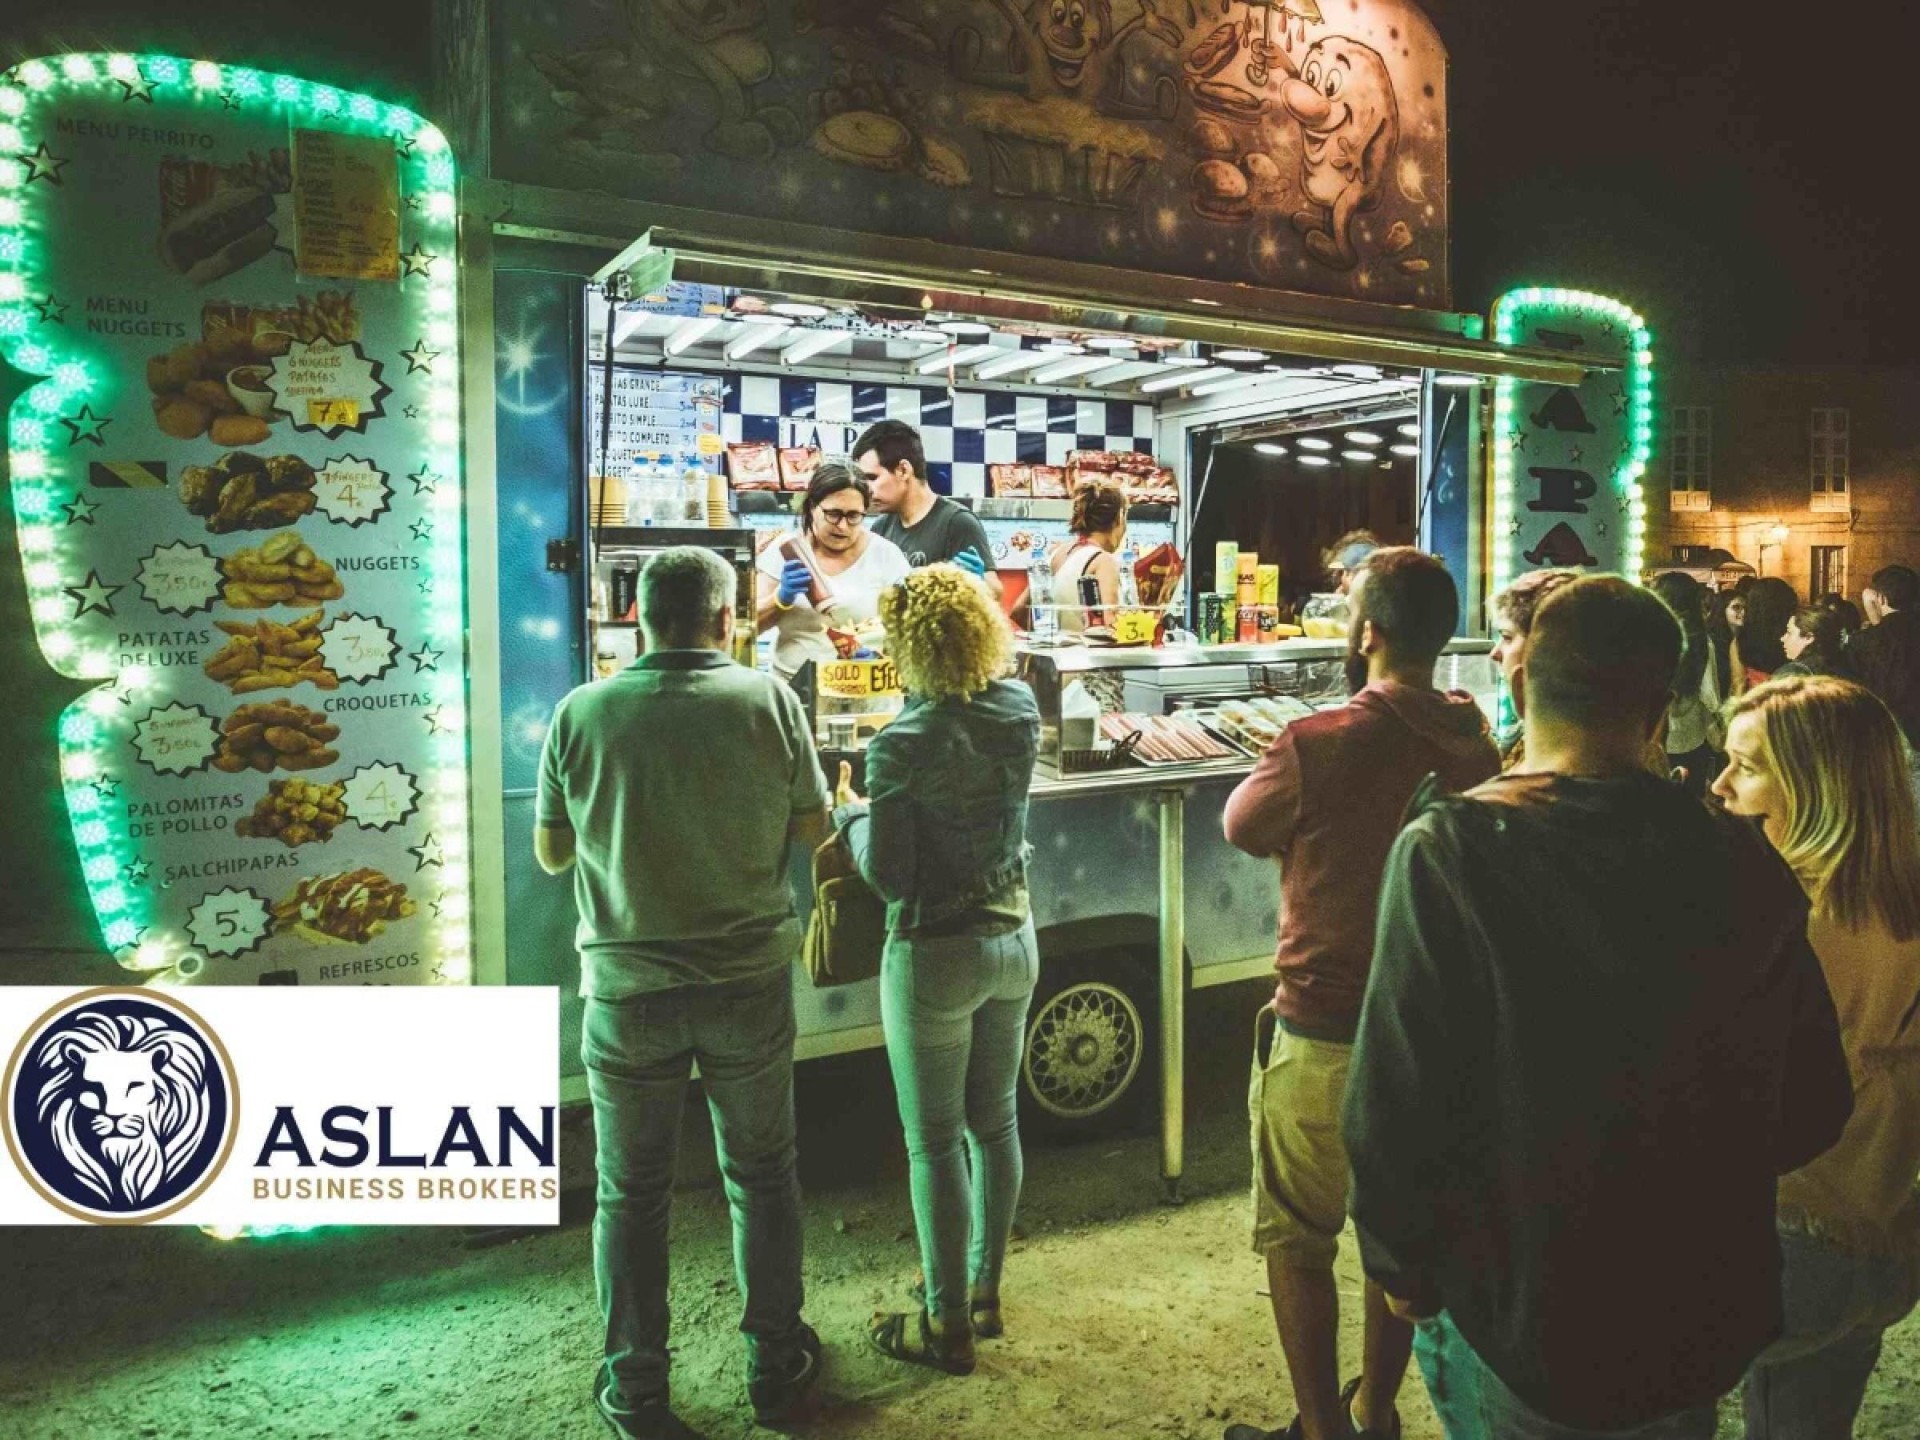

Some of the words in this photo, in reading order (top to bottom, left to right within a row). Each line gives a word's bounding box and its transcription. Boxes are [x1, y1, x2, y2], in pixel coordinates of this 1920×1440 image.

[57, 117, 119, 140] MENU
[127, 126, 214, 149] PERRITO
[86, 297, 149, 314] MENU
[87, 318, 185, 337] NUGGETS
[313, 401, 333, 422] 7
[335, 556, 420, 571] NUGGETS
[118, 630, 210, 648] PATATAS
[120, 651, 199, 668] DELUXE
[323, 692, 432, 713] CROQUETAS
[127, 793, 244, 818] PALOMITAS
[129, 822, 155, 838] DE
[163, 815, 228, 835] POLLO
[164, 852, 300, 881] SALCHIPAPAS
[319, 952, 419, 981] REFRESCOS
